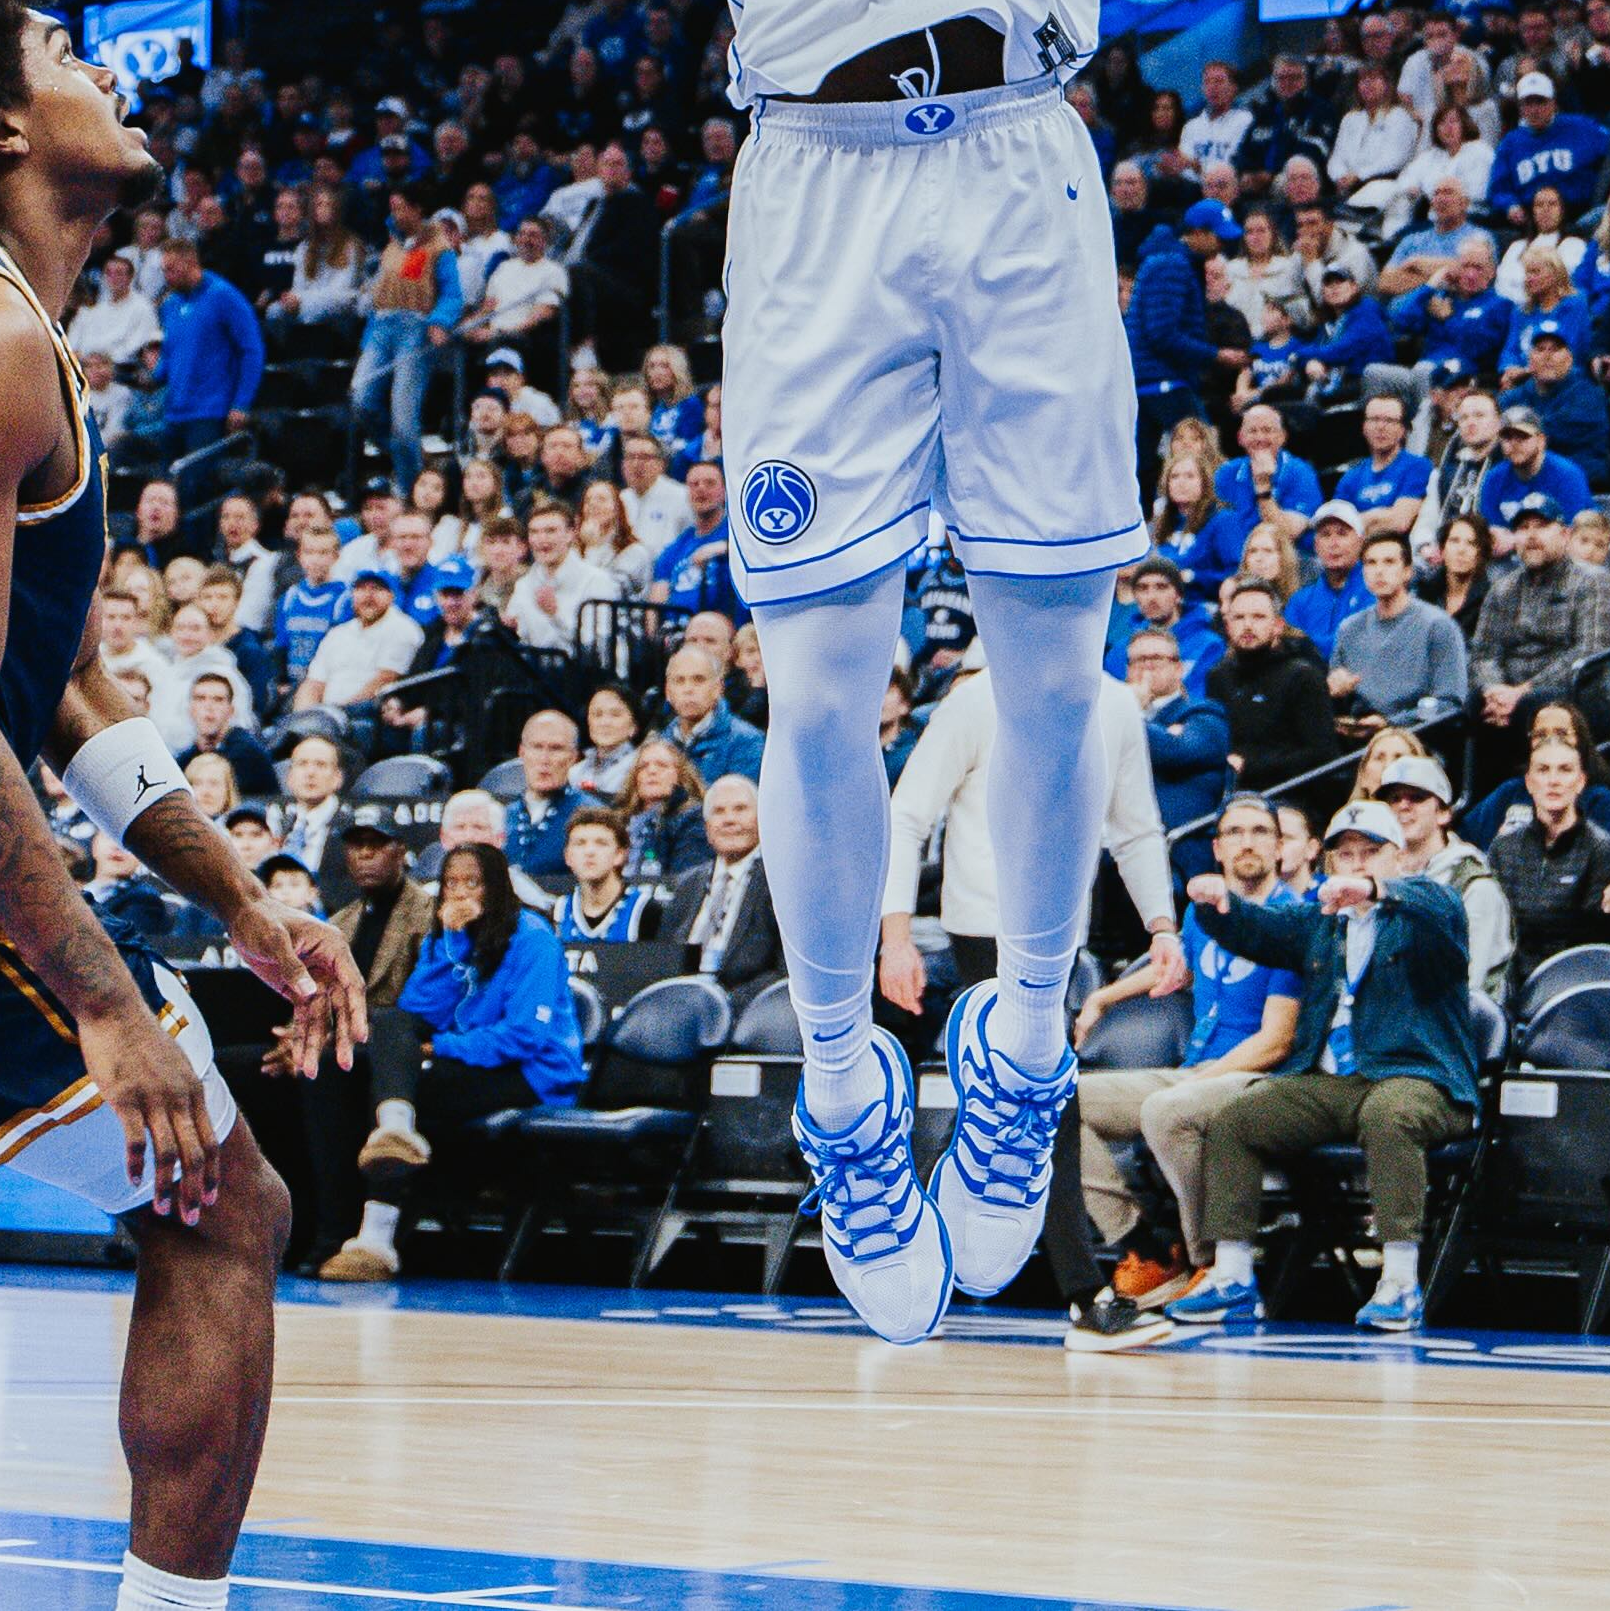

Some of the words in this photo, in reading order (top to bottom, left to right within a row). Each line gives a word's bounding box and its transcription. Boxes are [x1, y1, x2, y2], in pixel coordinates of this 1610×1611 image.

[916, 106, 946, 132] Y
[1516, 148, 1574, 185] BYU
[765, 510, 787, 531] Y
